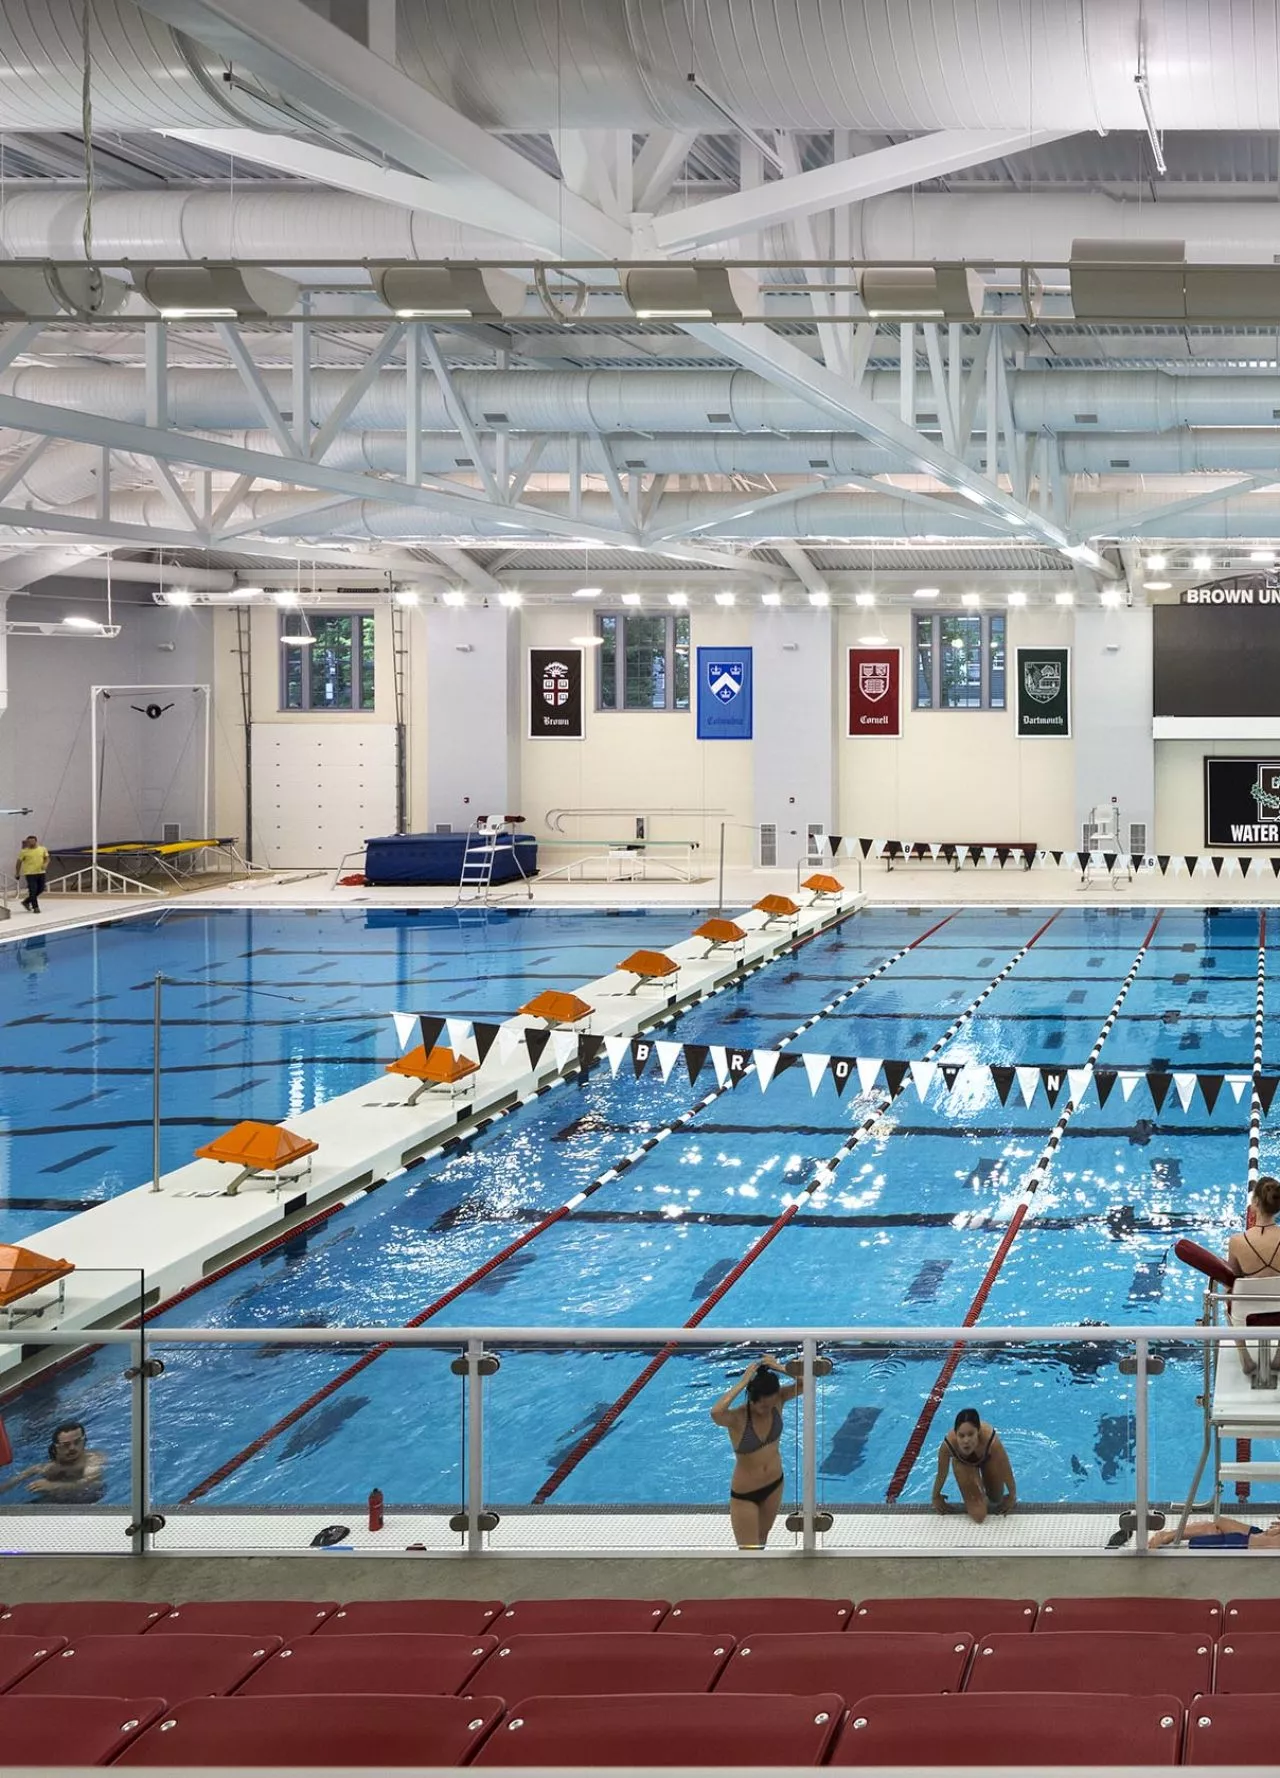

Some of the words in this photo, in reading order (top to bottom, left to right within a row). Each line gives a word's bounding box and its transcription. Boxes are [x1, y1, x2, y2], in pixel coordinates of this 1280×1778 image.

[1187, 589, 1253, 604] BROWN
[543, 716, 570, 726] Brown
[860, 715, 889, 725] Cornell
[1023, 715, 1064, 726] Dartmouth
[1230, 824, 1279, 842] WATER
[904, 845, 911, 853] 8
[1148, 858, 1154, 866] 6
